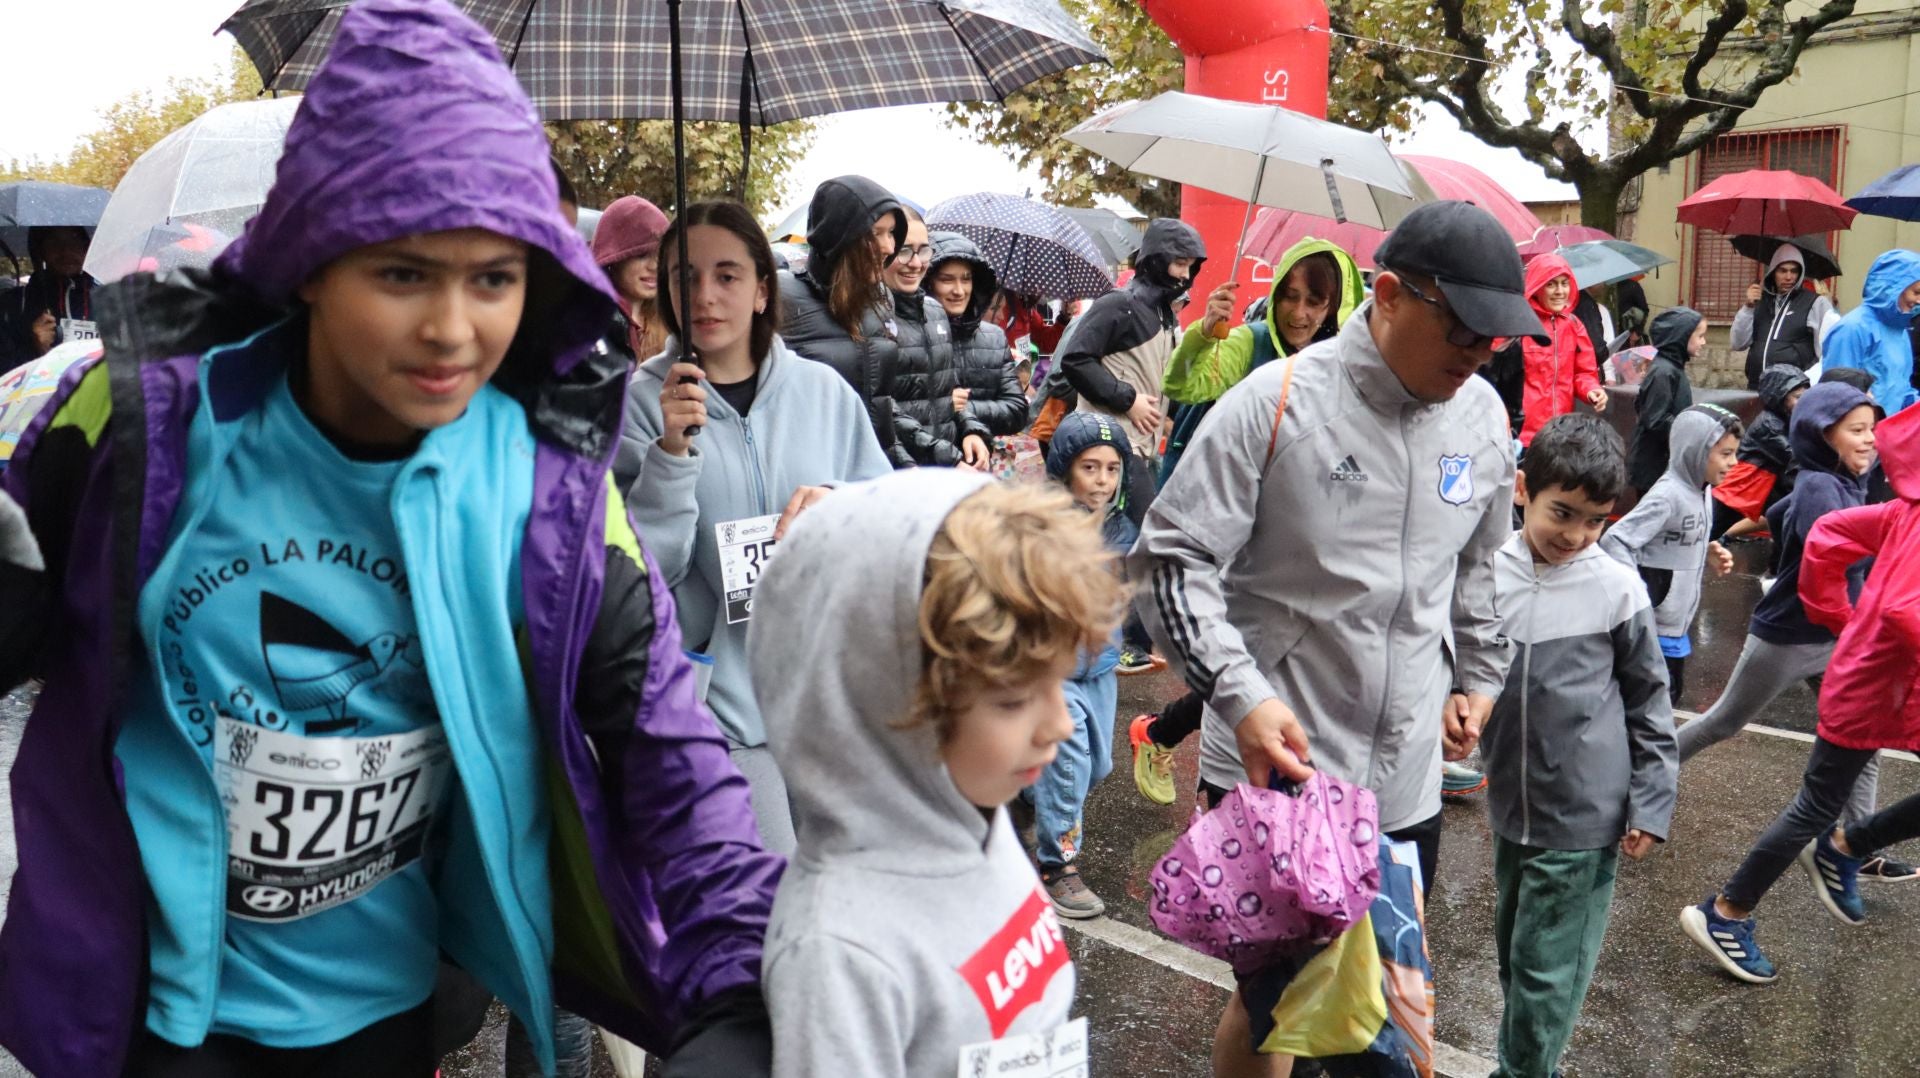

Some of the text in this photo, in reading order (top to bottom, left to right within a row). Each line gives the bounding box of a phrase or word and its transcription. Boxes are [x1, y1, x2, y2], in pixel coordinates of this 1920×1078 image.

[1330, 472, 1368, 482] adidas
[163, 558, 250, 635] Público
[260, 539, 304, 566] LA
[269, 753, 341, 770] emico
[356, 740, 392, 756] KAM
[250, 767, 421, 861] 3267
[299, 850, 397, 906] HYUNDAI
